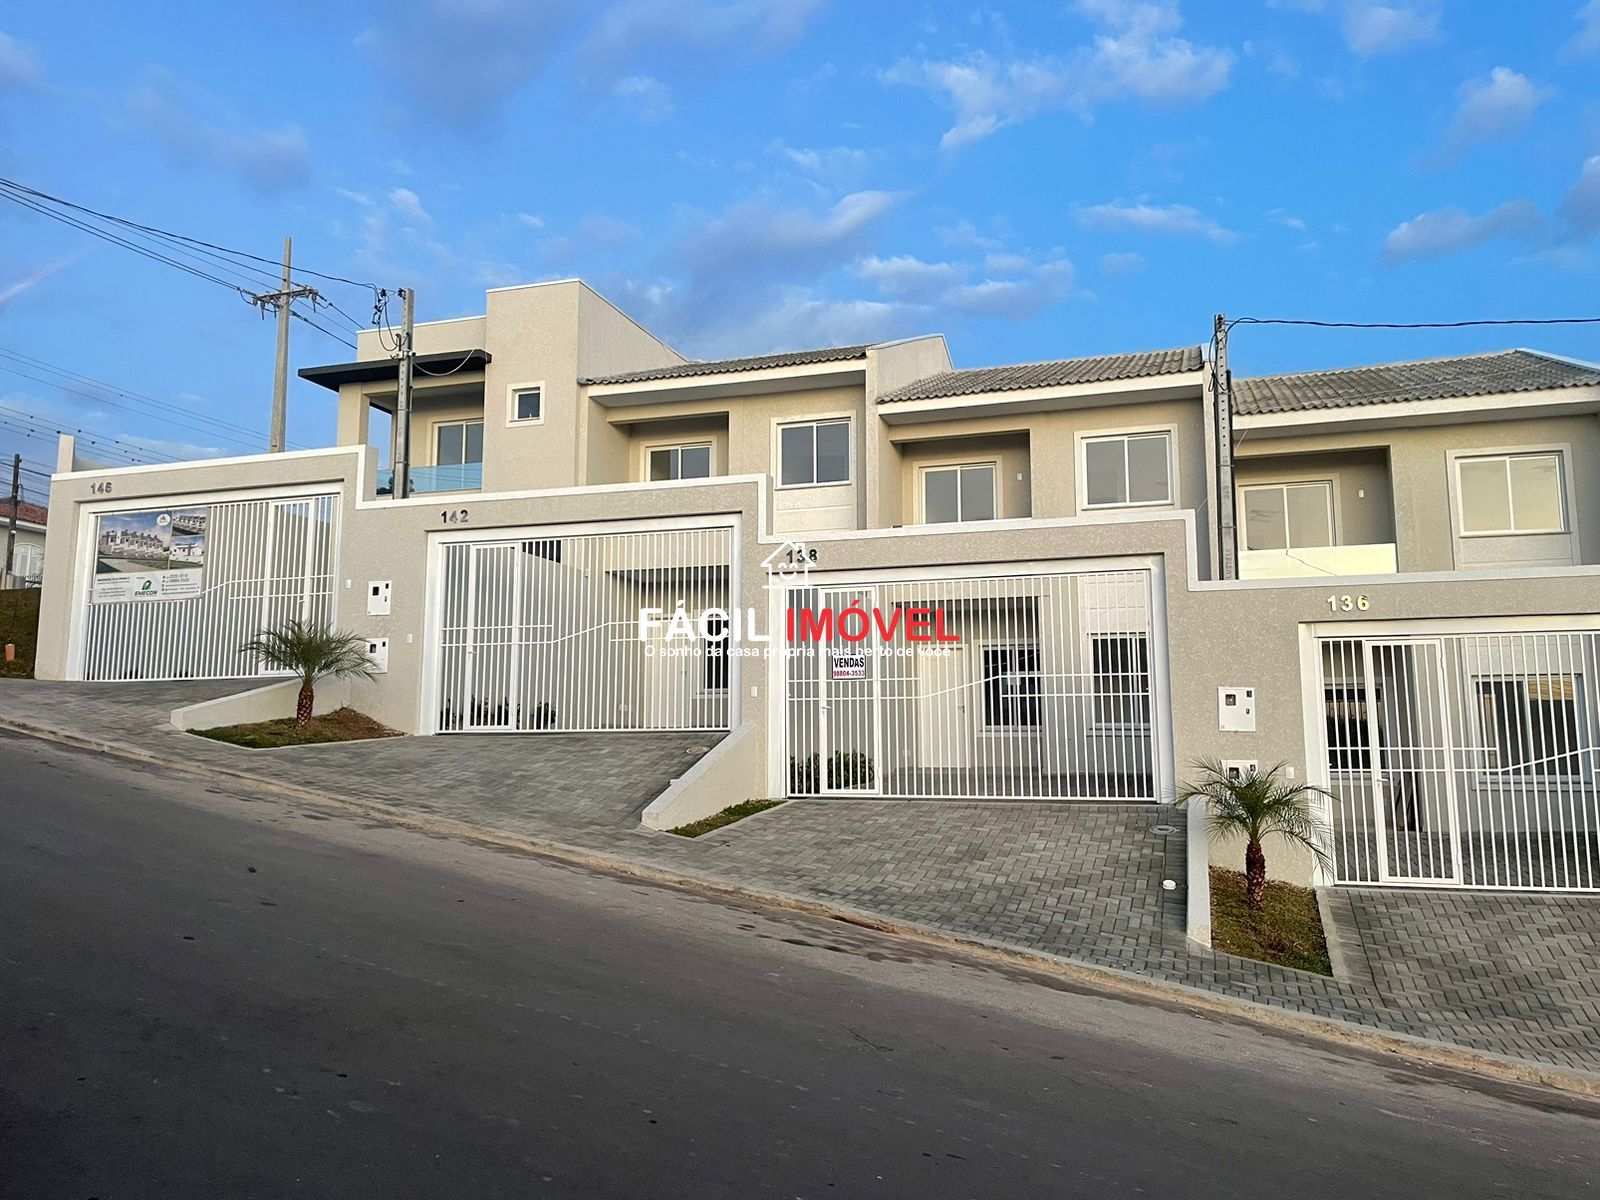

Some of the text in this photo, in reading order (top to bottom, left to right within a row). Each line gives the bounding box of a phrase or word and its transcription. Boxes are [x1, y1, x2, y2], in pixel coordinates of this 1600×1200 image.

[441, 509, 469, 524] 142
[786, 548, 818, 564] 138
[1326, 594, 1370, 612] 136
[834, 657, 865, 668] VENDAS
